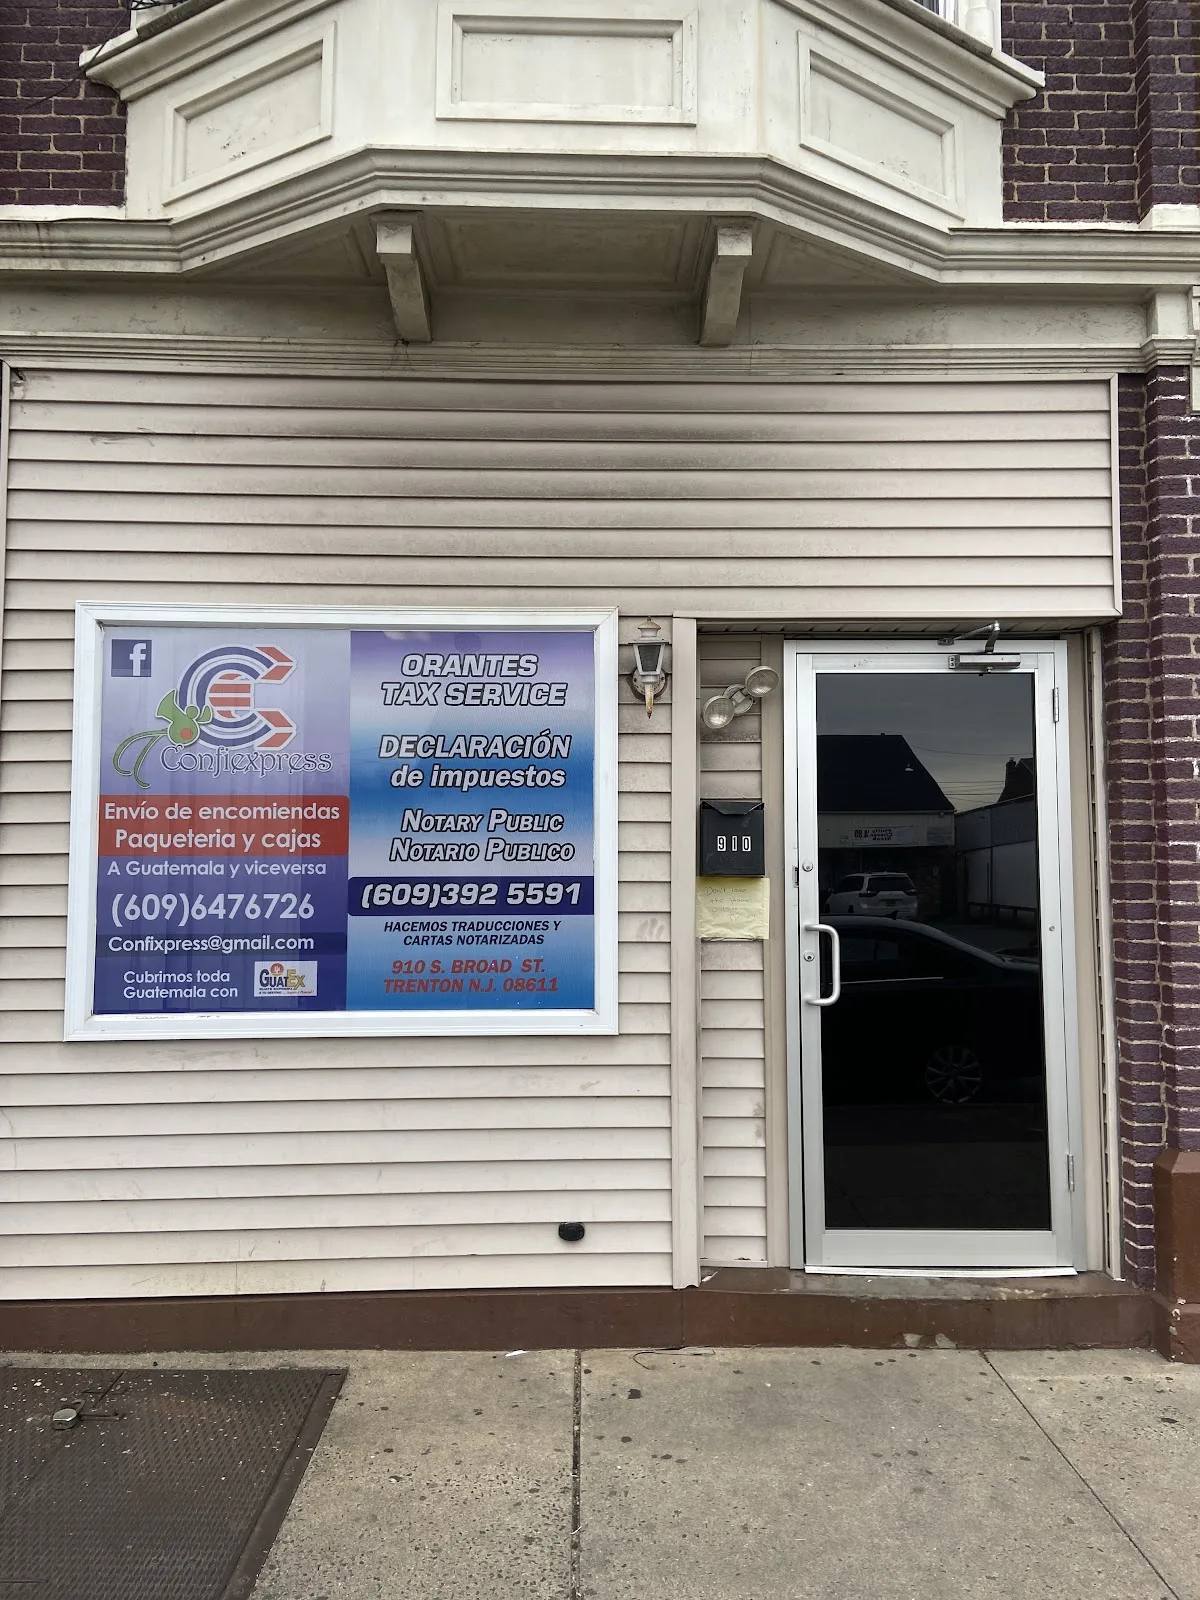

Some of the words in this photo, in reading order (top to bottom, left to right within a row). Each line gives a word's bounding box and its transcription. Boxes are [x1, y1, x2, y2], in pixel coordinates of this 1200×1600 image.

[401, 653, 539, 677] ORANTES
[381, 682, 441, 706] TAX
[444, 682, 568, 706] SERVICE
[378, 728, 572, 759] DECLARACIÓN
[160, 744, 332, 778] Confiexpress
[390, 764, 424, 787] de
[429, 764, 567, 792] impuestos
[104, 801, 159, 820] Envío
[165, 802, 192, 820] de
[198, 802, 340, 820] encomiendas
[115, 829, 236, 852] Paqueteria
[242, 833, 255, 852] y
[262, 829, 321, 852] cajas
[107, 861, 120, 876] A
[125, 860, 225, 876] Guatemala
[230, 863, 240, 878] y
[244, 861, 327, 876] viceversa
[361, 883, 498, 909] (609)392
[506, 883, 581, 905] 5591
[111, 893, 315, 927] (609)6476726
[384, 921, 448, 932] HACEMOS
[451, 920, 549, 932] TRADUCCIONES
[553, 920, 561, 930] Y
[108, 934, 314, 954] Confixpress@gmail.com
[403, 935, 453, 946] CARTAS
[456, 934, 545, 945] NOTARIZADAS
[391, 959, 426, 974] 910
[429, 959, 446, 974] S.
[451, 959, 513, 974] BROAD
[521, 958, 546, 973] ST.
[123, 971, 193, 983] Cubrimos
[196, 970, 231, 983] toda
[384, 979, 464, 993] TRENTON
[468, 978, 497, 992] N.J.
[502, 978, 559, 992] 08611
[123, 986, 206, 999] Guatemala
[210, 988, 238, 998] con
